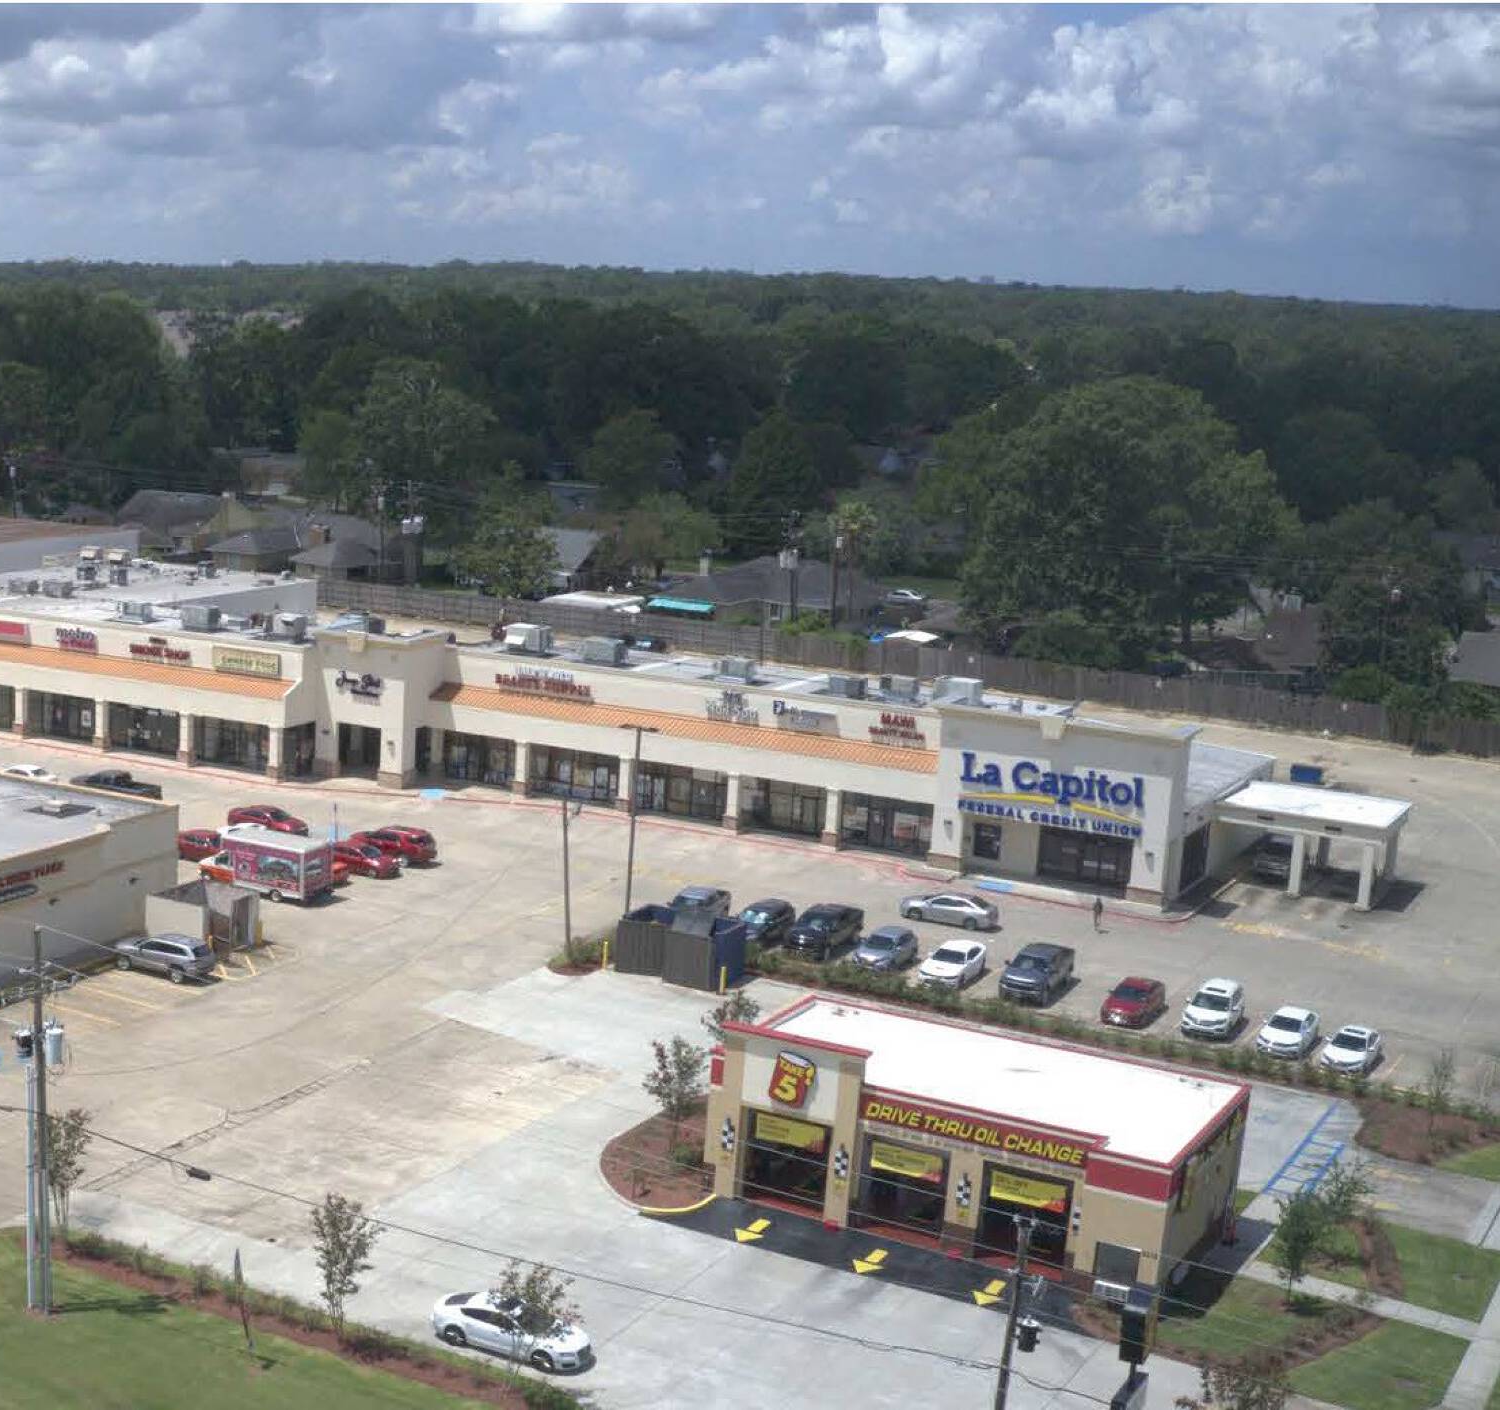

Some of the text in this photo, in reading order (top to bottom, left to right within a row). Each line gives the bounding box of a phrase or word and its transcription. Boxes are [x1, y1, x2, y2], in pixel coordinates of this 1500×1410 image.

[164, 648, 191, 660] SHOP
[960, 751, 1144, 808] La Capitol
[958, 799, 1142, 838] FEDERAL CREDIT UNION
[773, 1075, 797, 1101] 5
[866, 1103, 1085, 1164] DRIVE THRU OIL CHANGE
